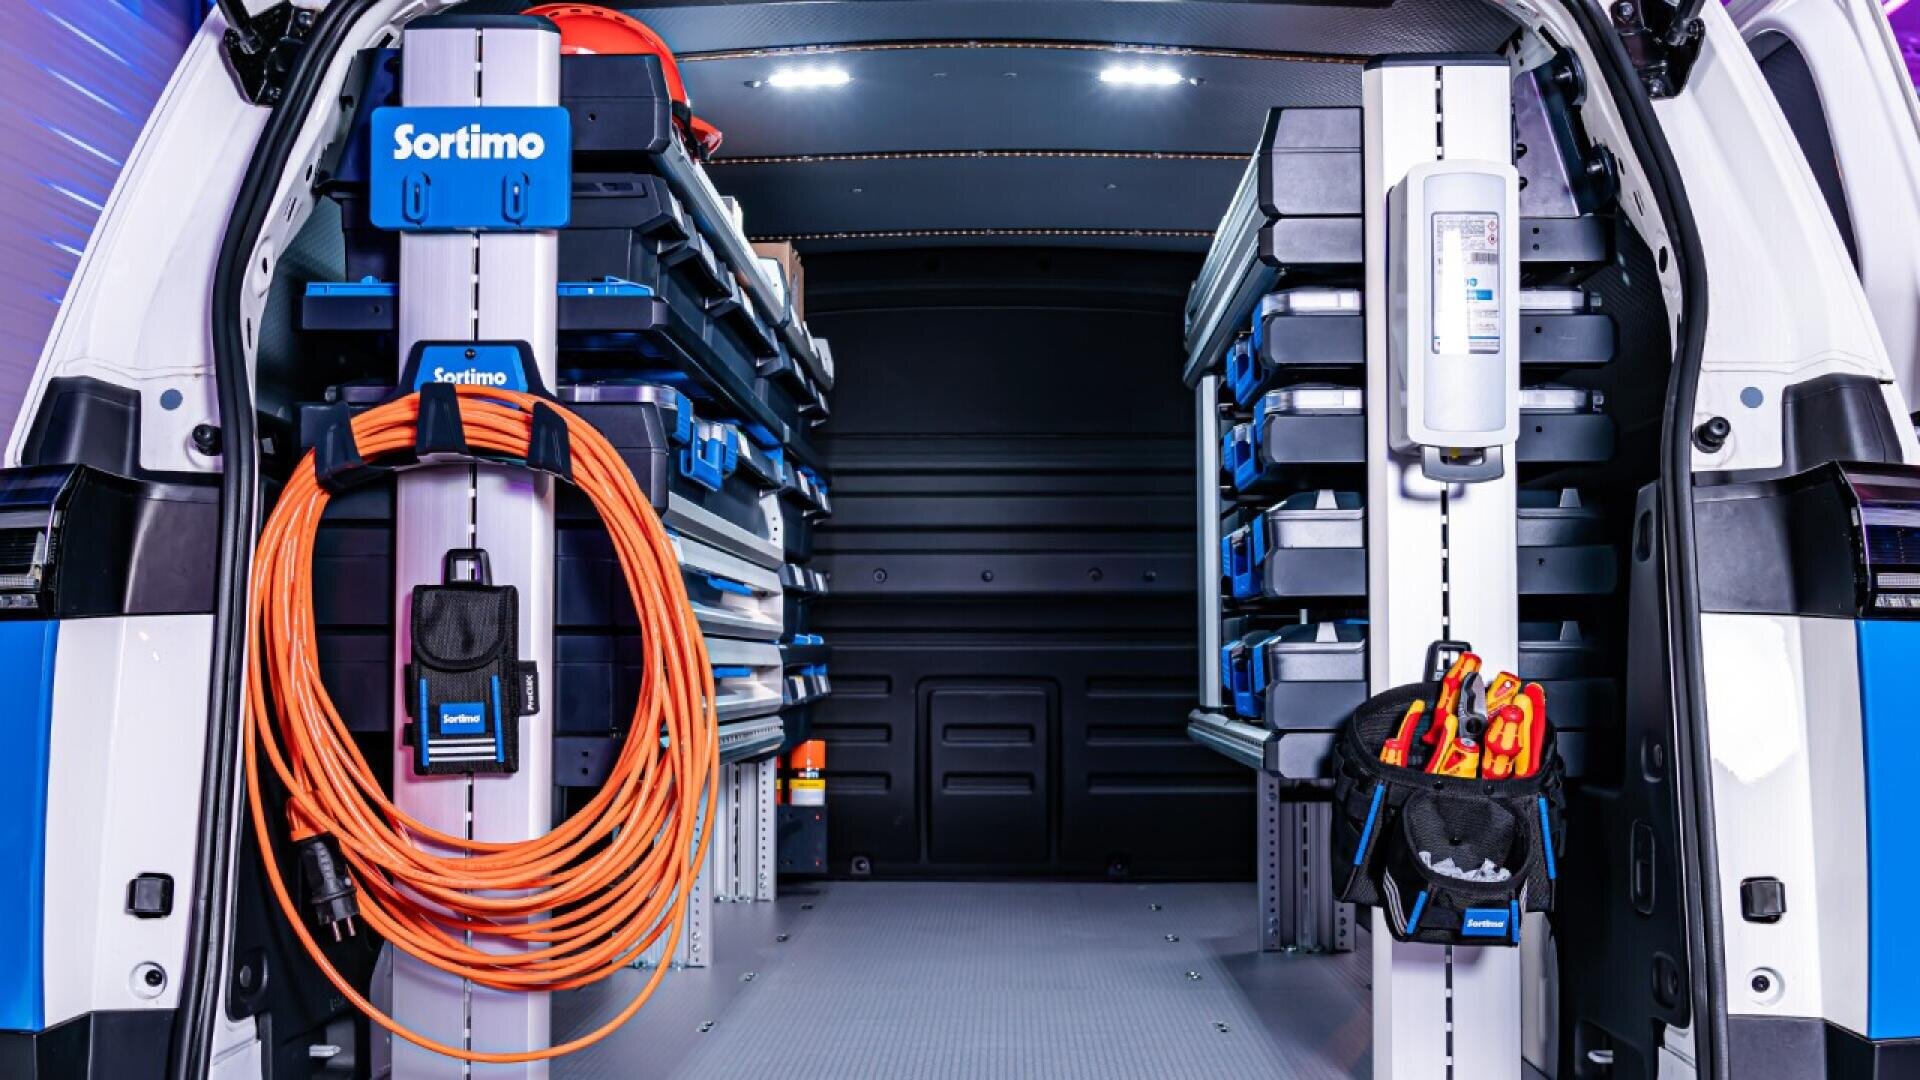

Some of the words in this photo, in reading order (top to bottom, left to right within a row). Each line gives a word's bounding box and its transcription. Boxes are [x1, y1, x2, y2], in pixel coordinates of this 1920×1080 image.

[393, 123, 545, 160] Sortimo
[434, 367, 507, 385] Sortimo
[443, 713, 481, 724] Sortimo
[1466, 918, 1505, 928] Sortimo
